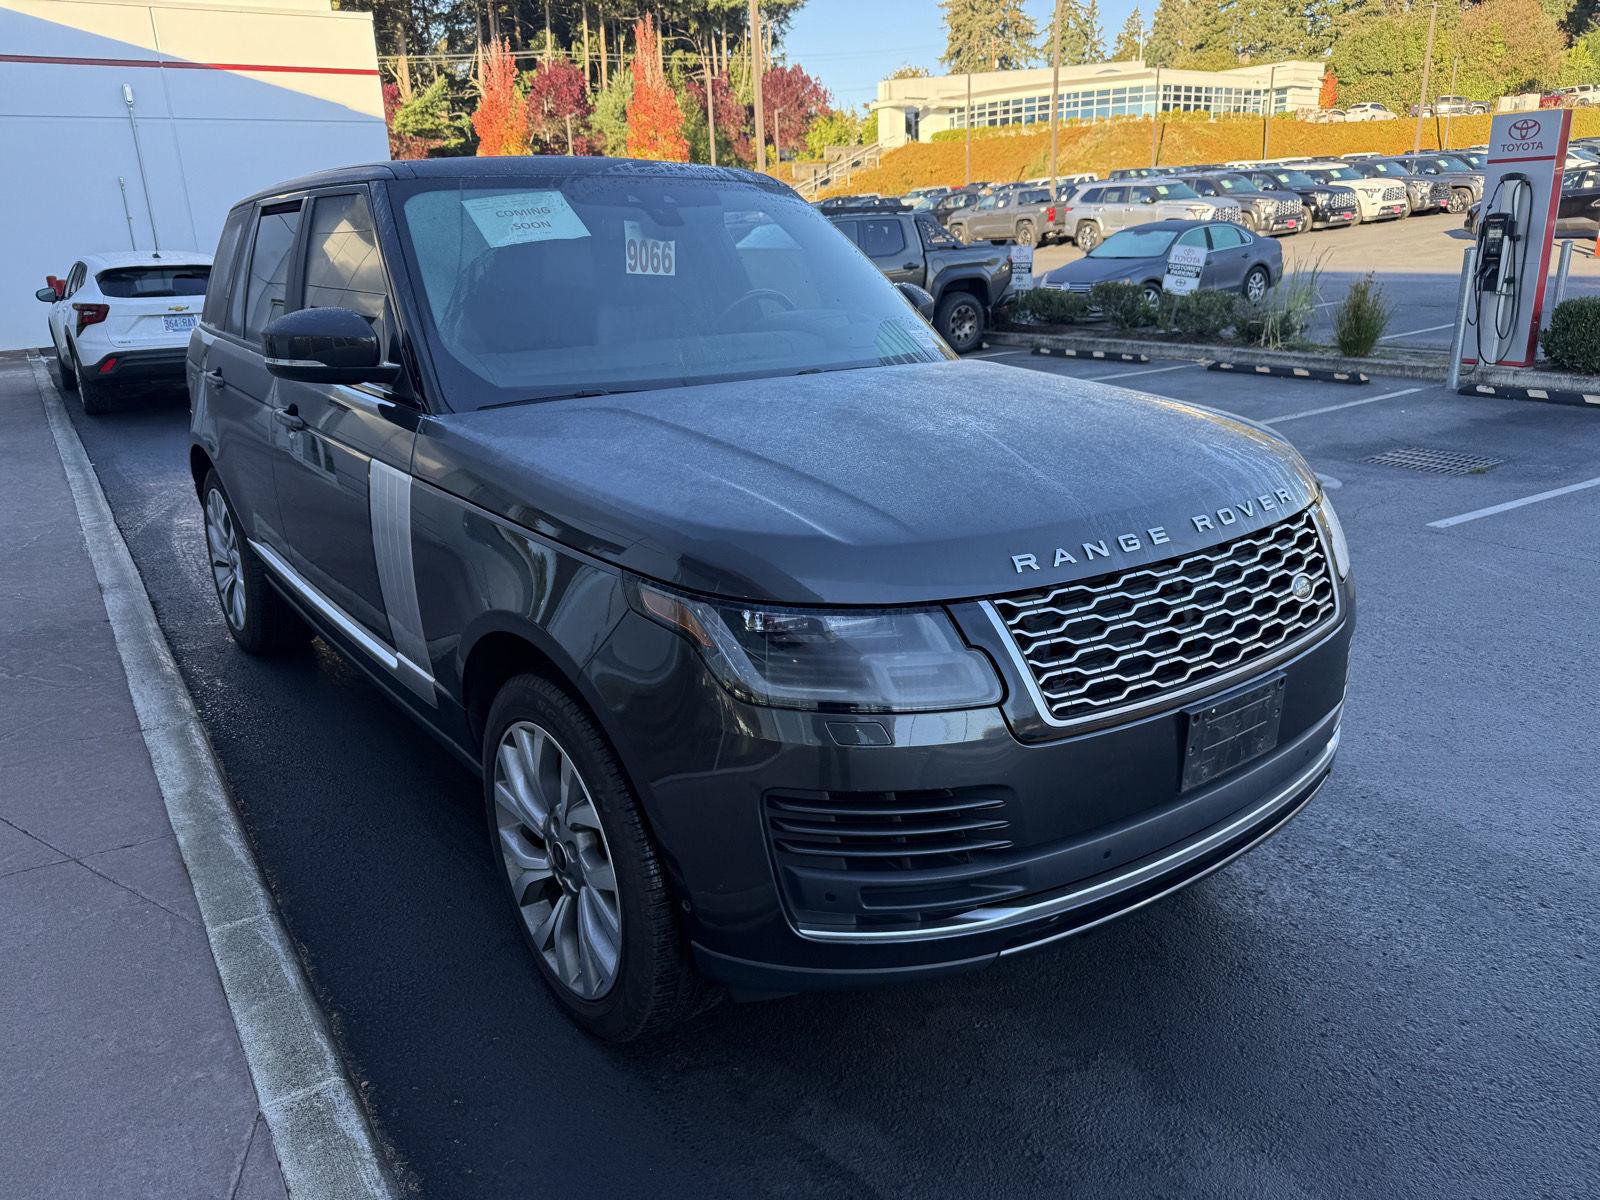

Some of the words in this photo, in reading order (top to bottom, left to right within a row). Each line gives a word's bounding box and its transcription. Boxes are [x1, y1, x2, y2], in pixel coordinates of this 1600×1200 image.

[1500, 141, 1544, 153] TOYOTA
[495, 206, 551, 218] COMING
[512, 221, 551, 230] SOON
[627, 238, 673, 274] 9066
[1174, 255, 1201, 264] TOYOTA
[1168, 263, 1201, 272] CUSTOMER
[1170, 269, 1197, 278] PARKING
[1011, 526, 1170, 574] RANGE
[1191, 487, 1292, 533] ROVER
